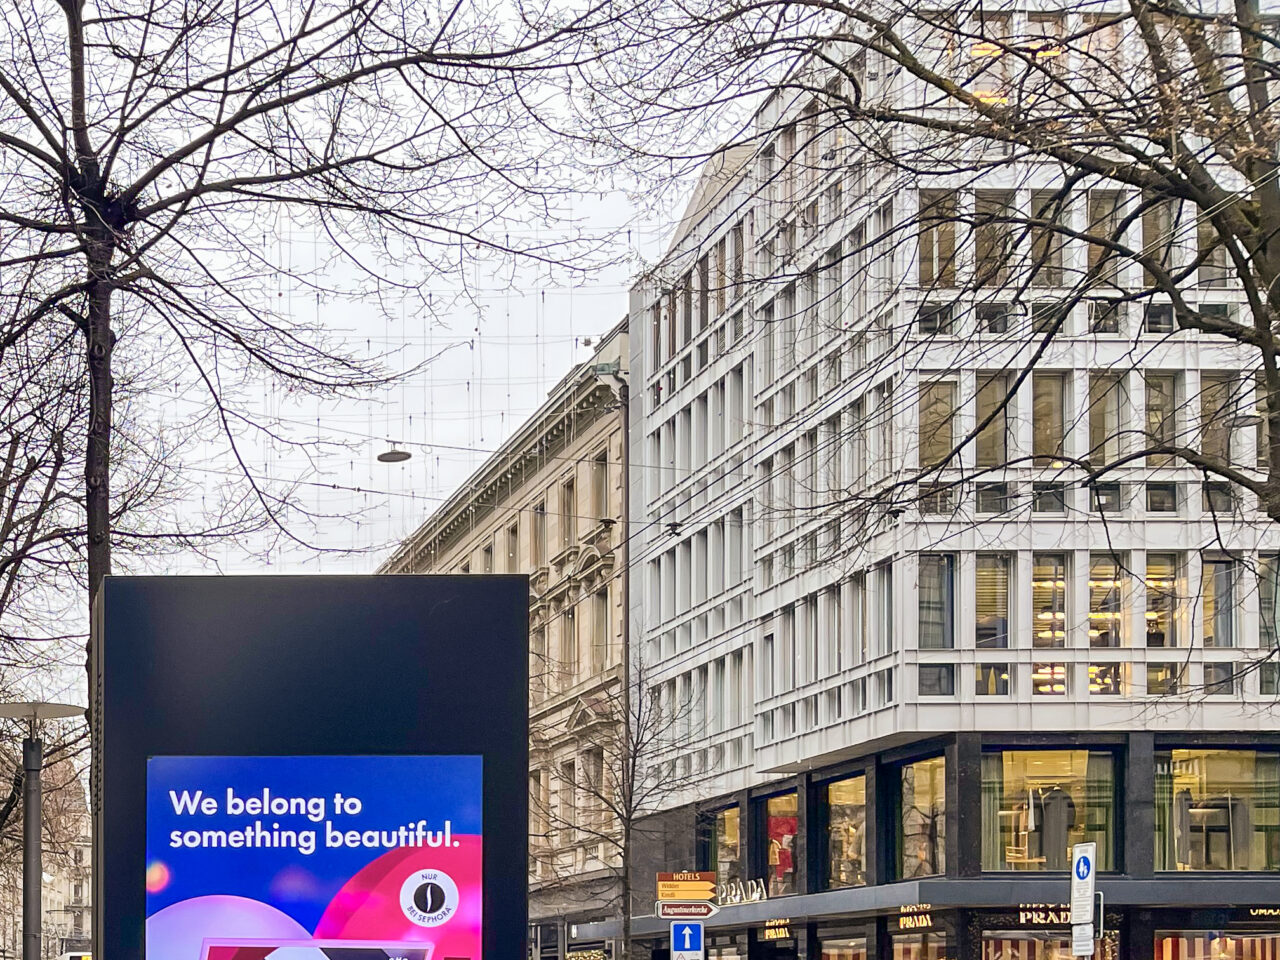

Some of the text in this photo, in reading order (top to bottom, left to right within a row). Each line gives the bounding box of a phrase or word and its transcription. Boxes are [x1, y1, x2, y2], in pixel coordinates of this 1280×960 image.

[169, 787, 362, 822] We belong to
[169, 820, 460, 855] something beautiful.
[717, 878, 768, 905] PRADA
[407, 905, 452, 923] BEI SEPHORA
[899, 914, 932, 929] PRADA
[1019, 911, 1072, 924] PRAD
